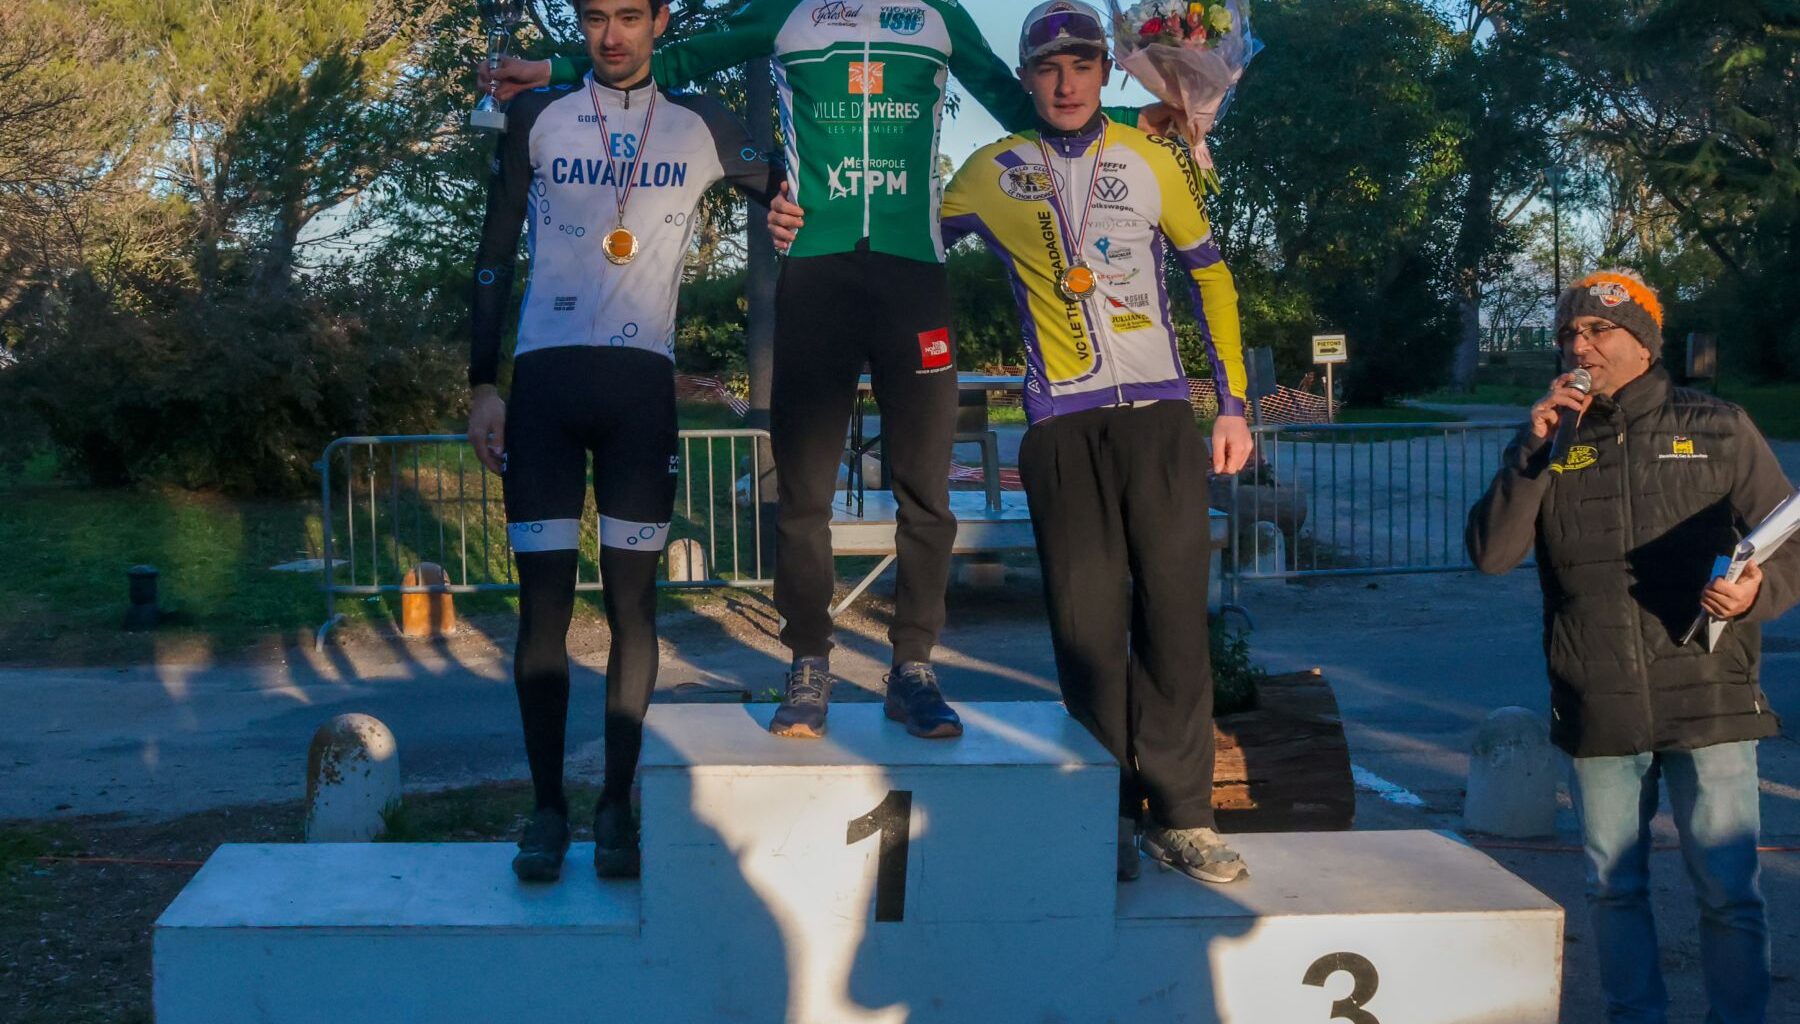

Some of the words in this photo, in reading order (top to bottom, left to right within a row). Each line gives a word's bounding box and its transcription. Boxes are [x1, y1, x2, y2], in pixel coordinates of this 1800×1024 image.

[813, 102, 846, 119] VILLE
[828, 126, 846, 134] LES
[851, 126, 905, 134] PAMIERS
[610, 133, 637, 158] ES
[552, 158, 688, 187] CAVAILLON
[845, 171, 907, 196] TPM
[1147, 133, 1207, 223] GADAGNE
[1091, 203, 1134, 212] olkswagen
[1070, 322, 1084, 339] LE
[1076, 341, 1089, 361] VC
[847, 790, 912, 922] 1
[1302, 952, 1380, 1024] 3
